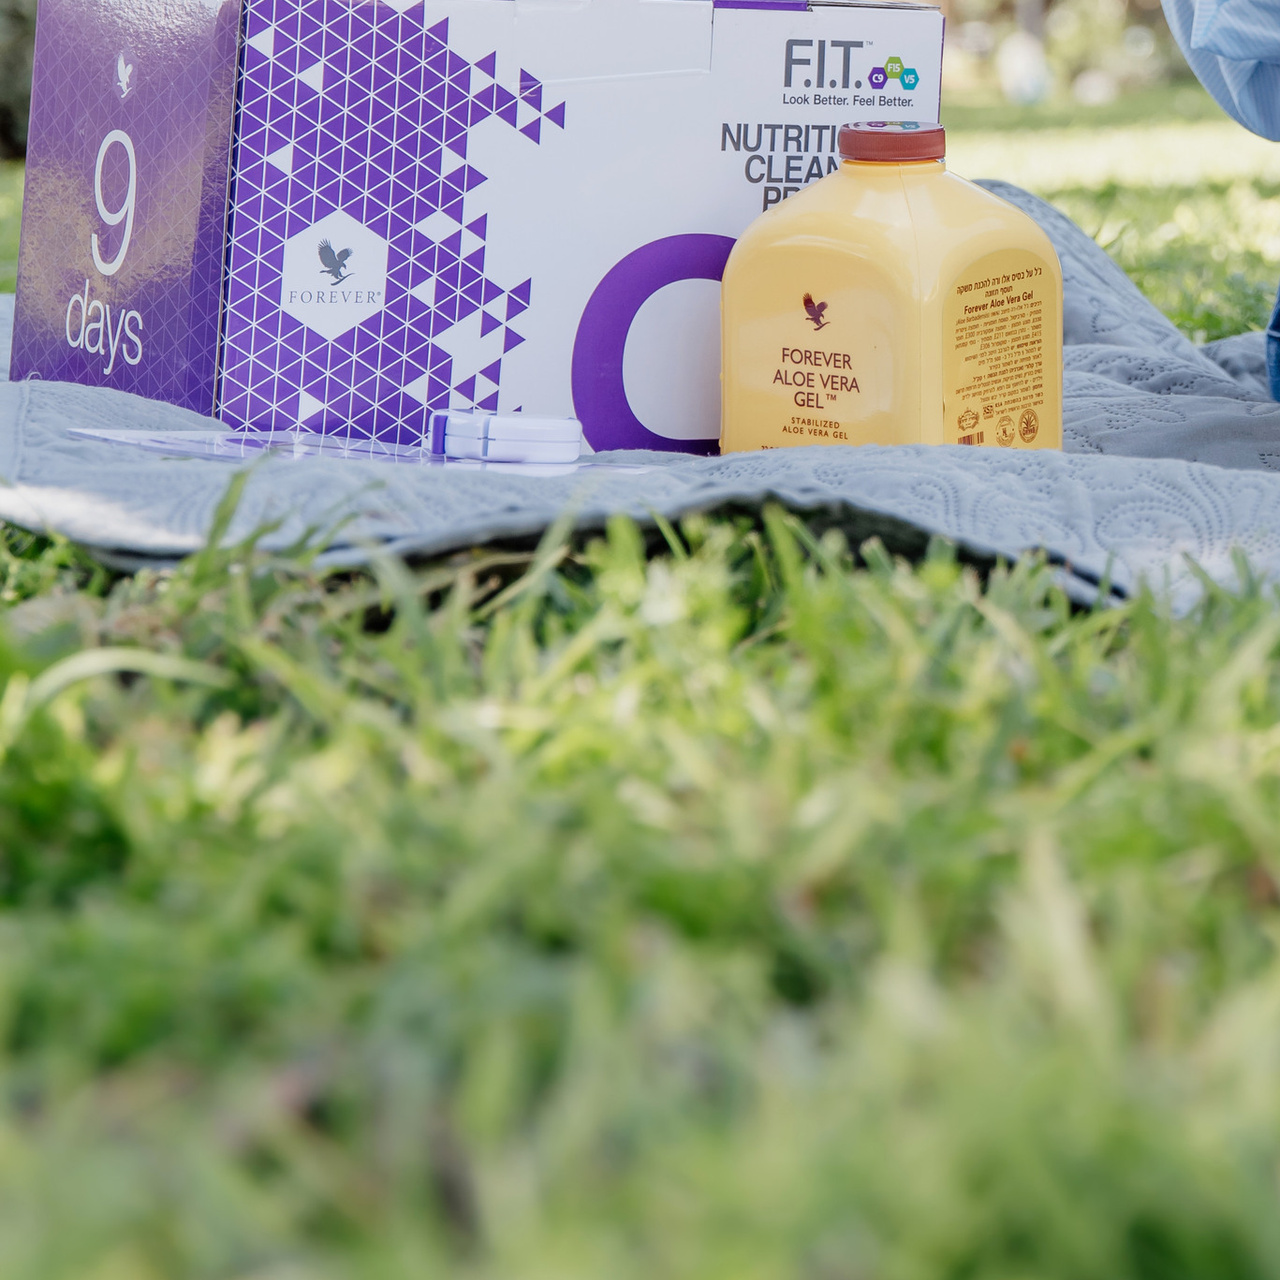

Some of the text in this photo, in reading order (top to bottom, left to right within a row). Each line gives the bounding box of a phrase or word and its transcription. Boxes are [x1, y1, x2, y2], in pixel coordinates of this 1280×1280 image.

[784, 39, 864, 89] F.I.T.
[872, 63, 915, 84] C9 F15 V5
[783, 94, 914, 107] Look Better. Feel Better.
[721, 123, 840, 153] NUTRITI
[90, 129, 137, 276] 9
[964, 302, 988, 315] Forever
[990, 299, 1004, 308] Aloe
[1006, 294, 1020, 305] Vera
[1022, 290, 1033, 301] Gel
[65, 278, 143, 375] days
[782, 347, 852, 370] FOREVER
[773, 369, 860, 393] ALOE VERA
[794, 391, 824, 409] GEL
[782, 426, 848, 440] ALOE VERA GEL
[791, 417, 840, 429] STABILIZED
